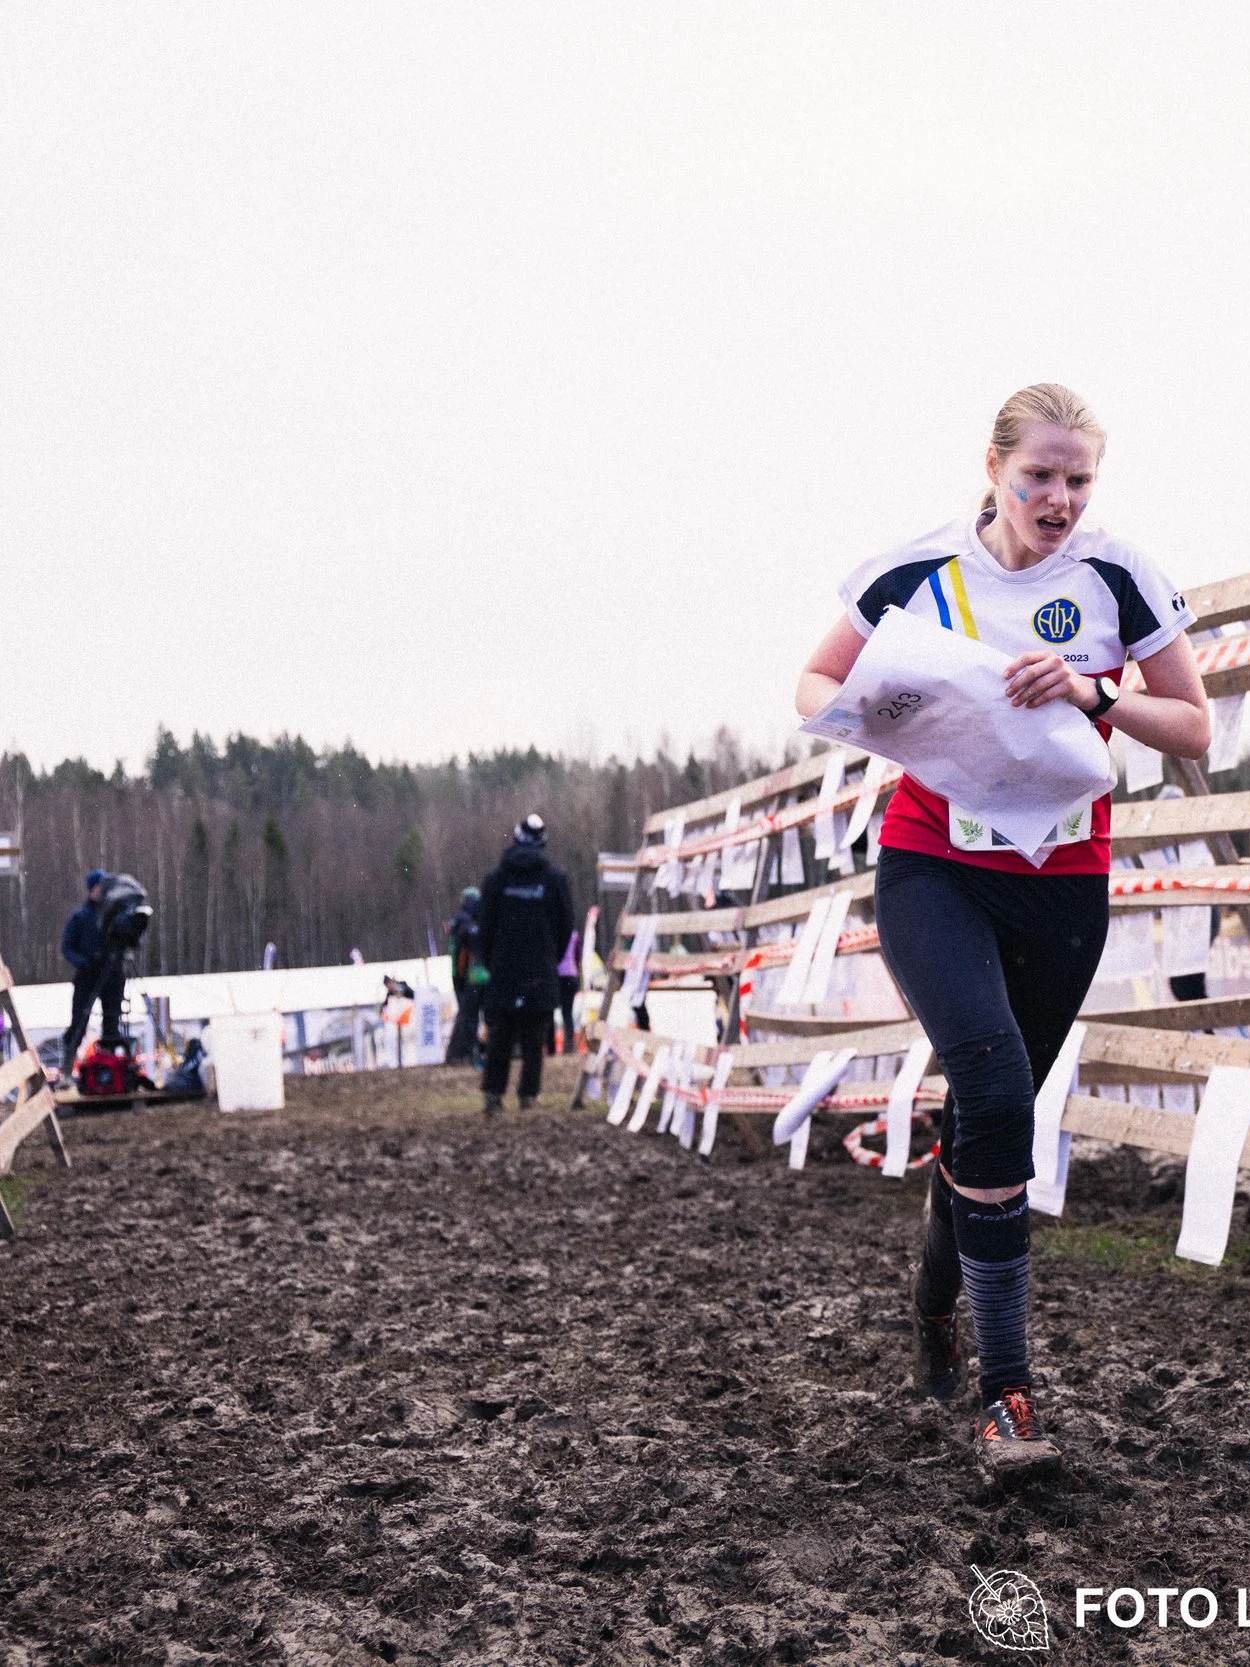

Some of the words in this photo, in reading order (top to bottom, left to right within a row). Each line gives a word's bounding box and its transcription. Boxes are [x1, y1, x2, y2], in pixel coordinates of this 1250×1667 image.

[1036, 600, 1077, 640] AIK
[1063, 654, 1089, 662] 2023
[877, 693, 922, 719] 243
